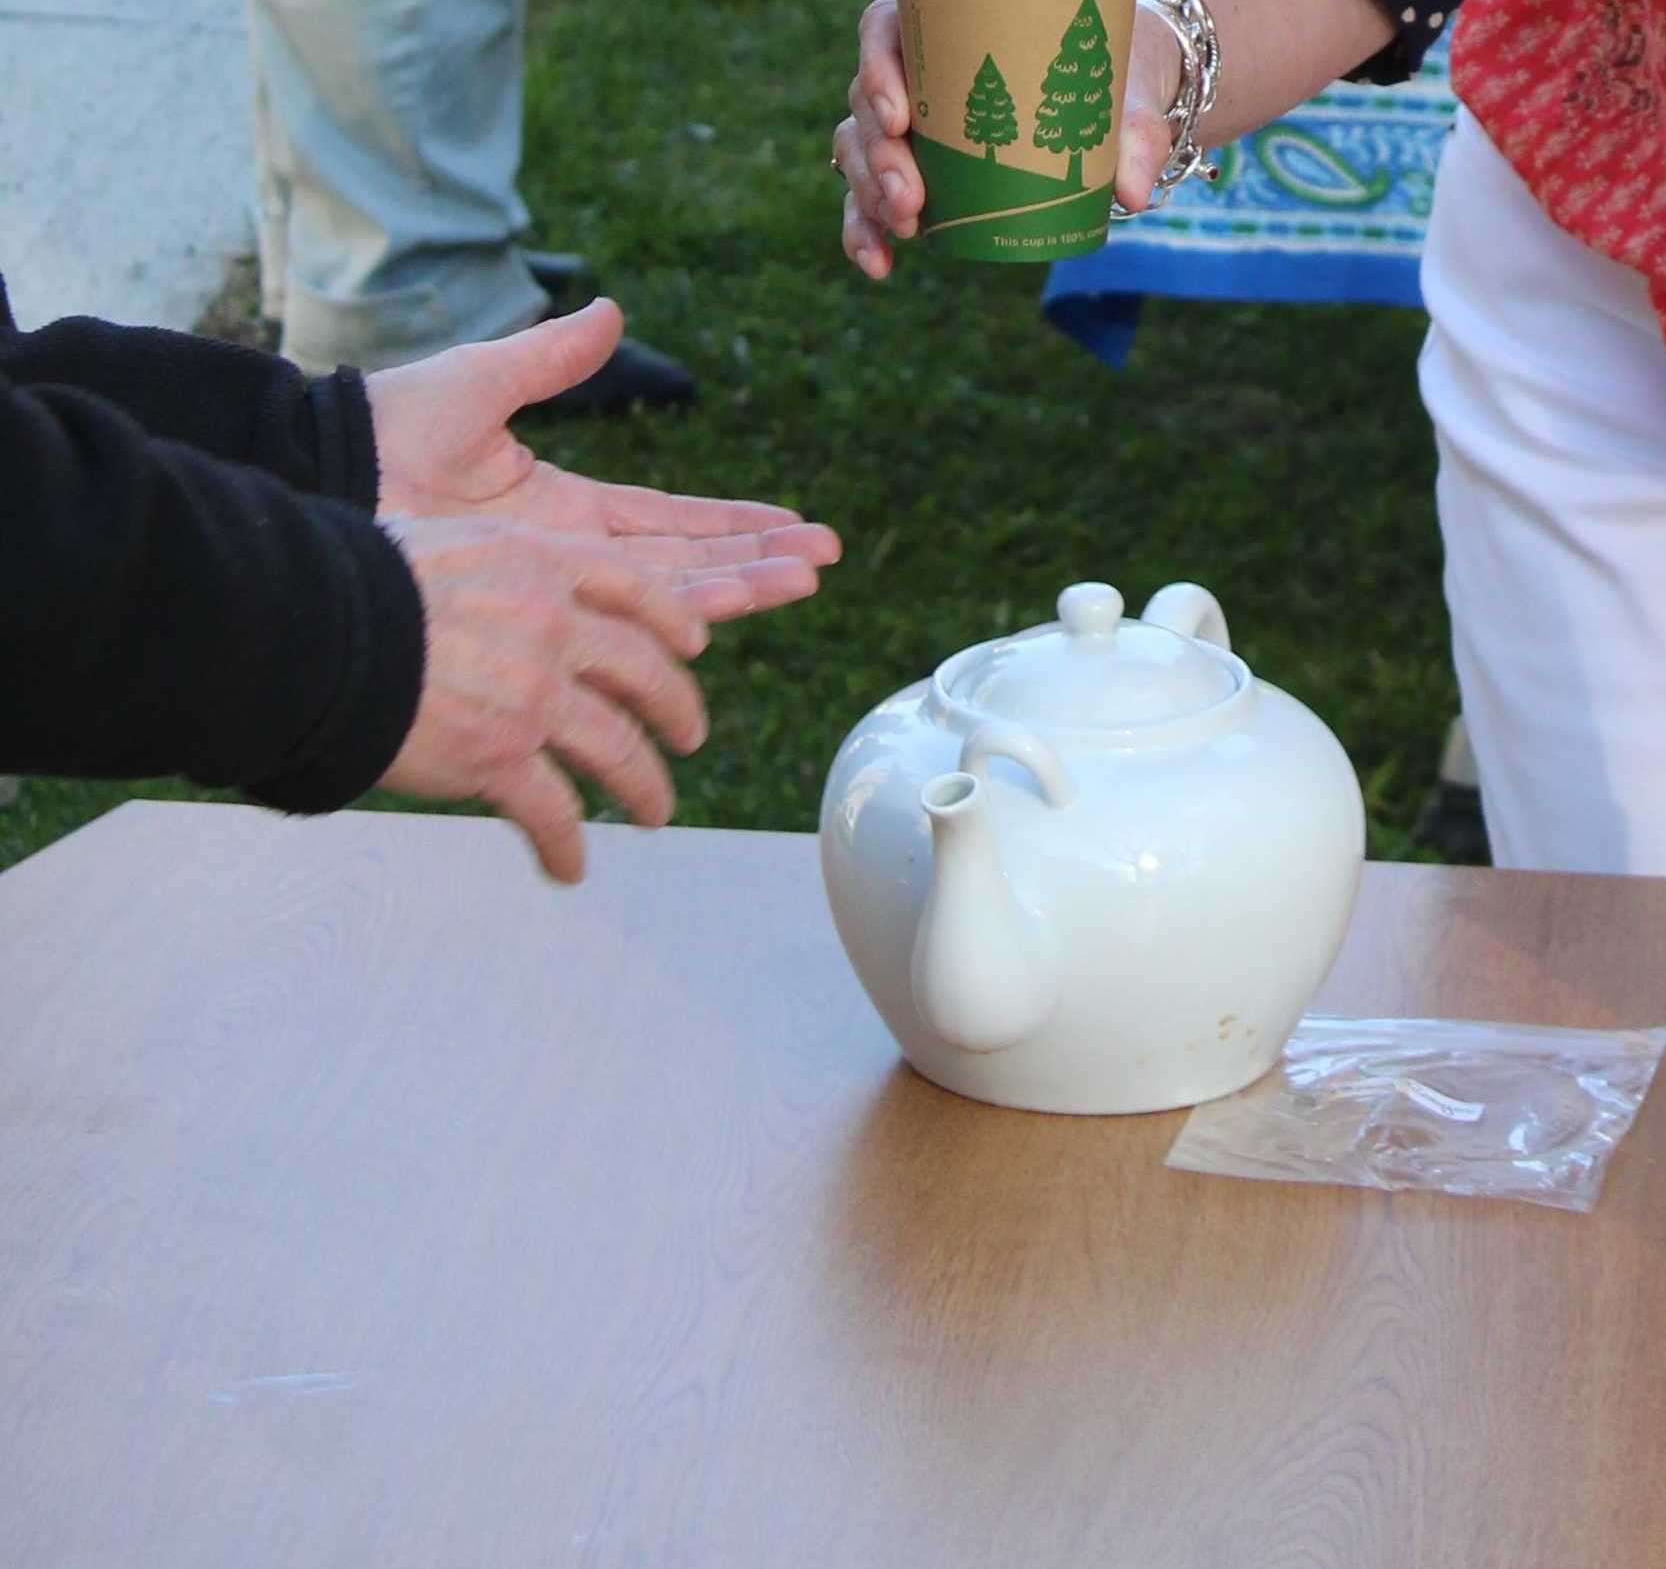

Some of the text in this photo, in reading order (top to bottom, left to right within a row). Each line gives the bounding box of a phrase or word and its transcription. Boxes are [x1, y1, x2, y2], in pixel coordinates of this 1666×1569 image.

[993, 236, 1019, 247] This
[1022, 238, 1044, 248] cup
[1047, 236, 1057, 246] is
